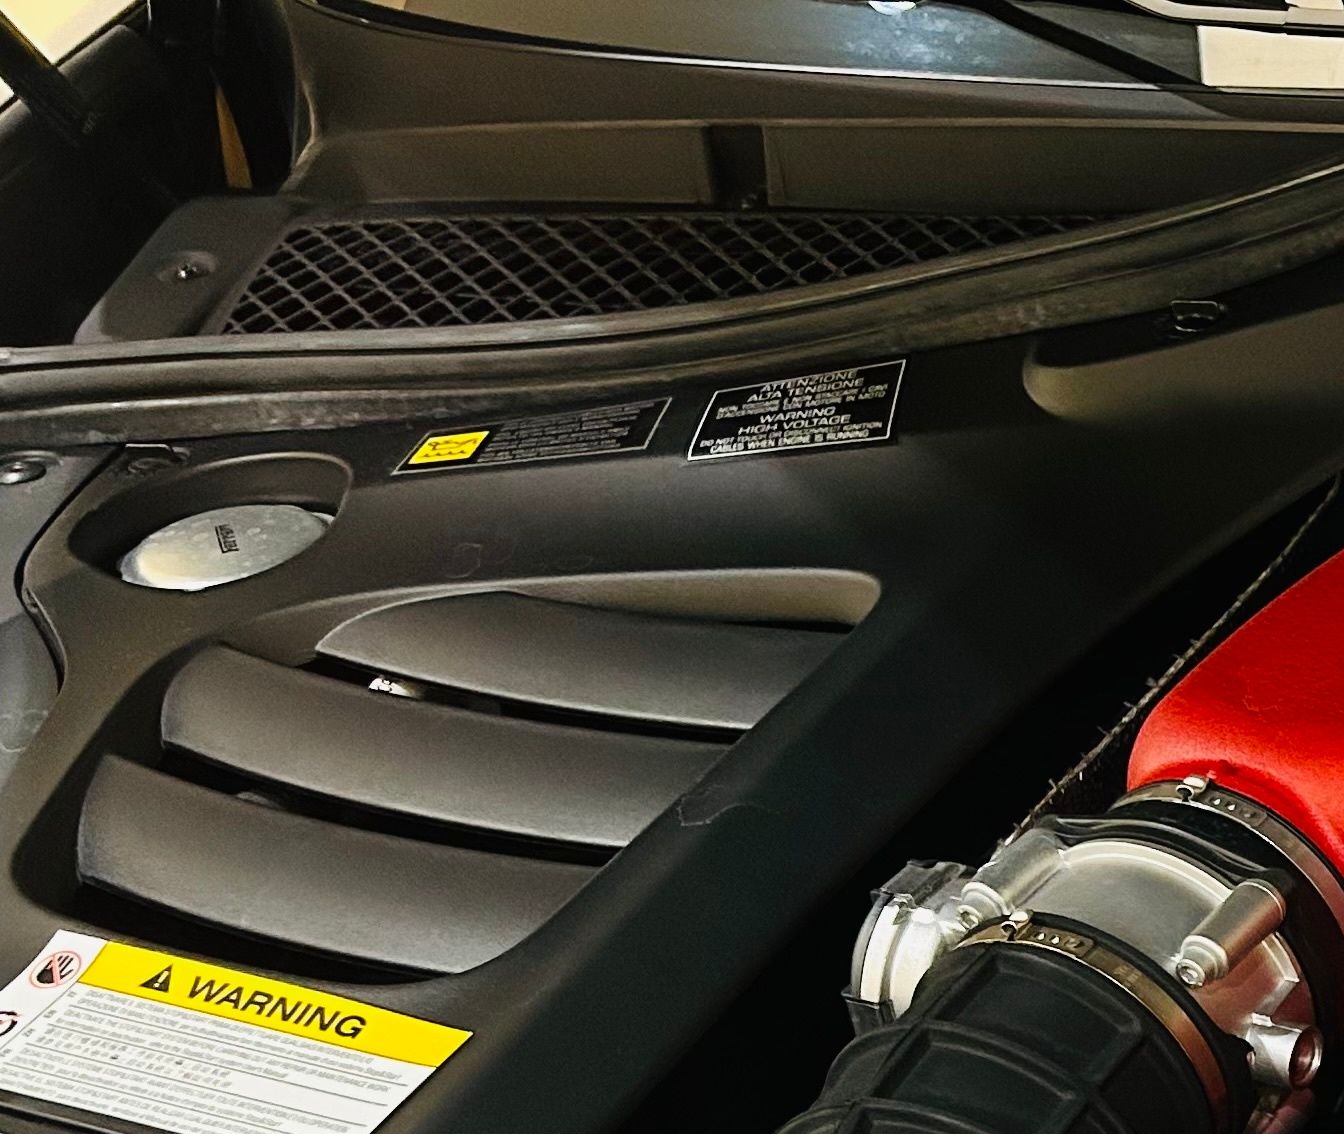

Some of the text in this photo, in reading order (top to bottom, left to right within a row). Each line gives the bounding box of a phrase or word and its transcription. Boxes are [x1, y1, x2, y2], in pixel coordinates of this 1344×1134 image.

[747, 378, 864, 402] ALTA TENSIONE
[760, 370, 857, 393] ATTENZIONE
[738, 414, 852, 435] HIGH VOLTAGE
[760, 406, 836, 423] WARNING
[187, 976, 367, 1039] WARNING
